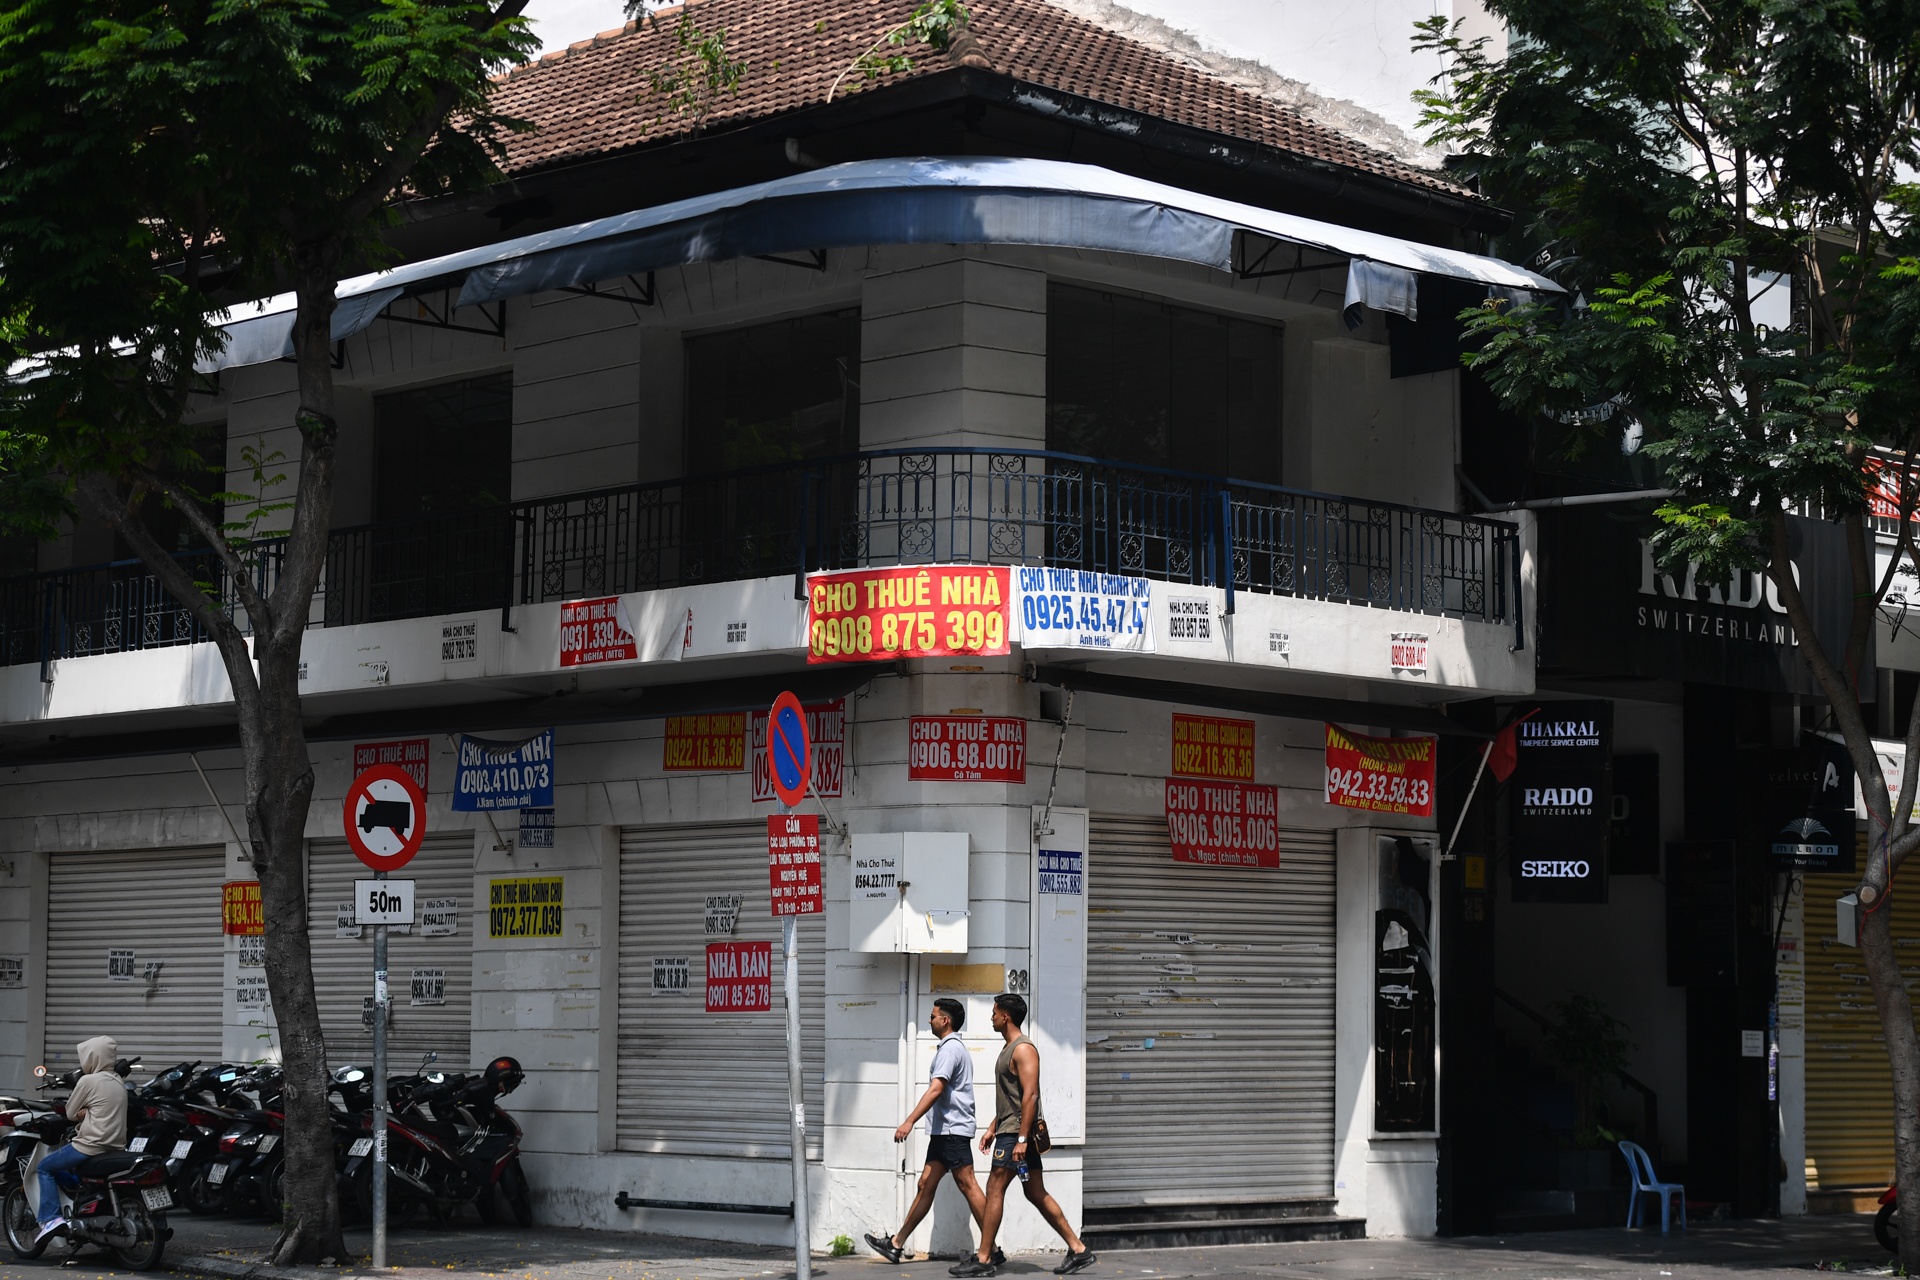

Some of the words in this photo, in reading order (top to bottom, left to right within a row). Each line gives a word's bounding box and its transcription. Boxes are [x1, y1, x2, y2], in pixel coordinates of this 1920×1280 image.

[1020, 568, 1045, 592] CHO
[813, 584, 857, 614] CHO
[864, 570, 931, 608] THUÊ
[942, 570, 1001, 606] NHÀ
[562, 605, 574, 623] NHÀ
[576, 607, 588, 621] CHO
[590, 601, 605, 619] THUÊ
[1169, 600, 1181, 614] NHÀ
[1182, 602, 1193, 614] CHO
[1194, 601, 1208, 615] THUÊ
[453, 628, 462, 637] CHO
[812, 615, 873, 656] 0908
[881, 612, 937, 651] 875
[946, 610, 1005, 650] 399
[1170, 617, 1185, 638] 0933
[1198, 618, 1210, 639] 550
[819, 703, 844, 742] THUÊ
[912, 722, 941, 740] CHO
[947, 719, 988, 741] THUÊ
[994, 721, 1023, 742] NHÀ
[1175, 720, 1187, 741] CHO
[1189, 719, 1204, 743] THUÊ
[1205, 720, 1218, 744] NHÀ
[1520, 720, 1599, 737] THAKRAL
[357, 748, 375, 765] CHO
[379, 742, 403, 763] THUÊ
[405, 741, 426, 761] NHÀ
[522, 731, 551, 762] NHÀ
[666, 738, 742, 767] 0922.16.36.36
[1519, 739, 1549, 747] TIMEPIECE
[1576, 738, 1599, 746] CENTER
[911, 742, 1023, 770] 0906.98.0017
[1175, 743, 1251, 778] 0922.16.36.36
[460, 763, 549, 793] 0903.410.073
[954, 770, 964, 779] Cô
[966, 770, 982, 779] Tám
[1167, 784, 1199, 811] CHO
[1203, 784, 1241, 814] THUÊ
[1245, 787, 1276, 816] NHÀ
[1339, 795, 1357, 807] Liên
[1523, 787, 1593, 806] RADO
[1523, 808, 1592, 816] SWITZERLAND
[786, 815, 800, 833] CẤM
[1168, 811, 1276, 851] 0906.905.006
[856, 859, 867, 868] Nhà
[869, 859, 880, 868] Cho
[881, 858, 895, 868] Thuê
[1188, 849, 1195, 860] A.
[1521, 860, 1589, 878] SEIKO
[855, 873, 895, 889] 0564.22.7777
[225, 886, 243, 902] CHO
[370, 891, 402, 913] 50m
[491, 884, 502, 905] CHO
[423, 912, 456, 926] 0564.22.7777
[490, 905, 561, 937] 0972.377.039
[709, 945, 738, 978] NHÀ
[741, 945, 769, 978] BÁN
[708, 985, 728, 1007] 0901
[732, 985, 743, 1006] 85
[745, 984, 756, 1006] 25
[758, 984, 769, 1006] 78
